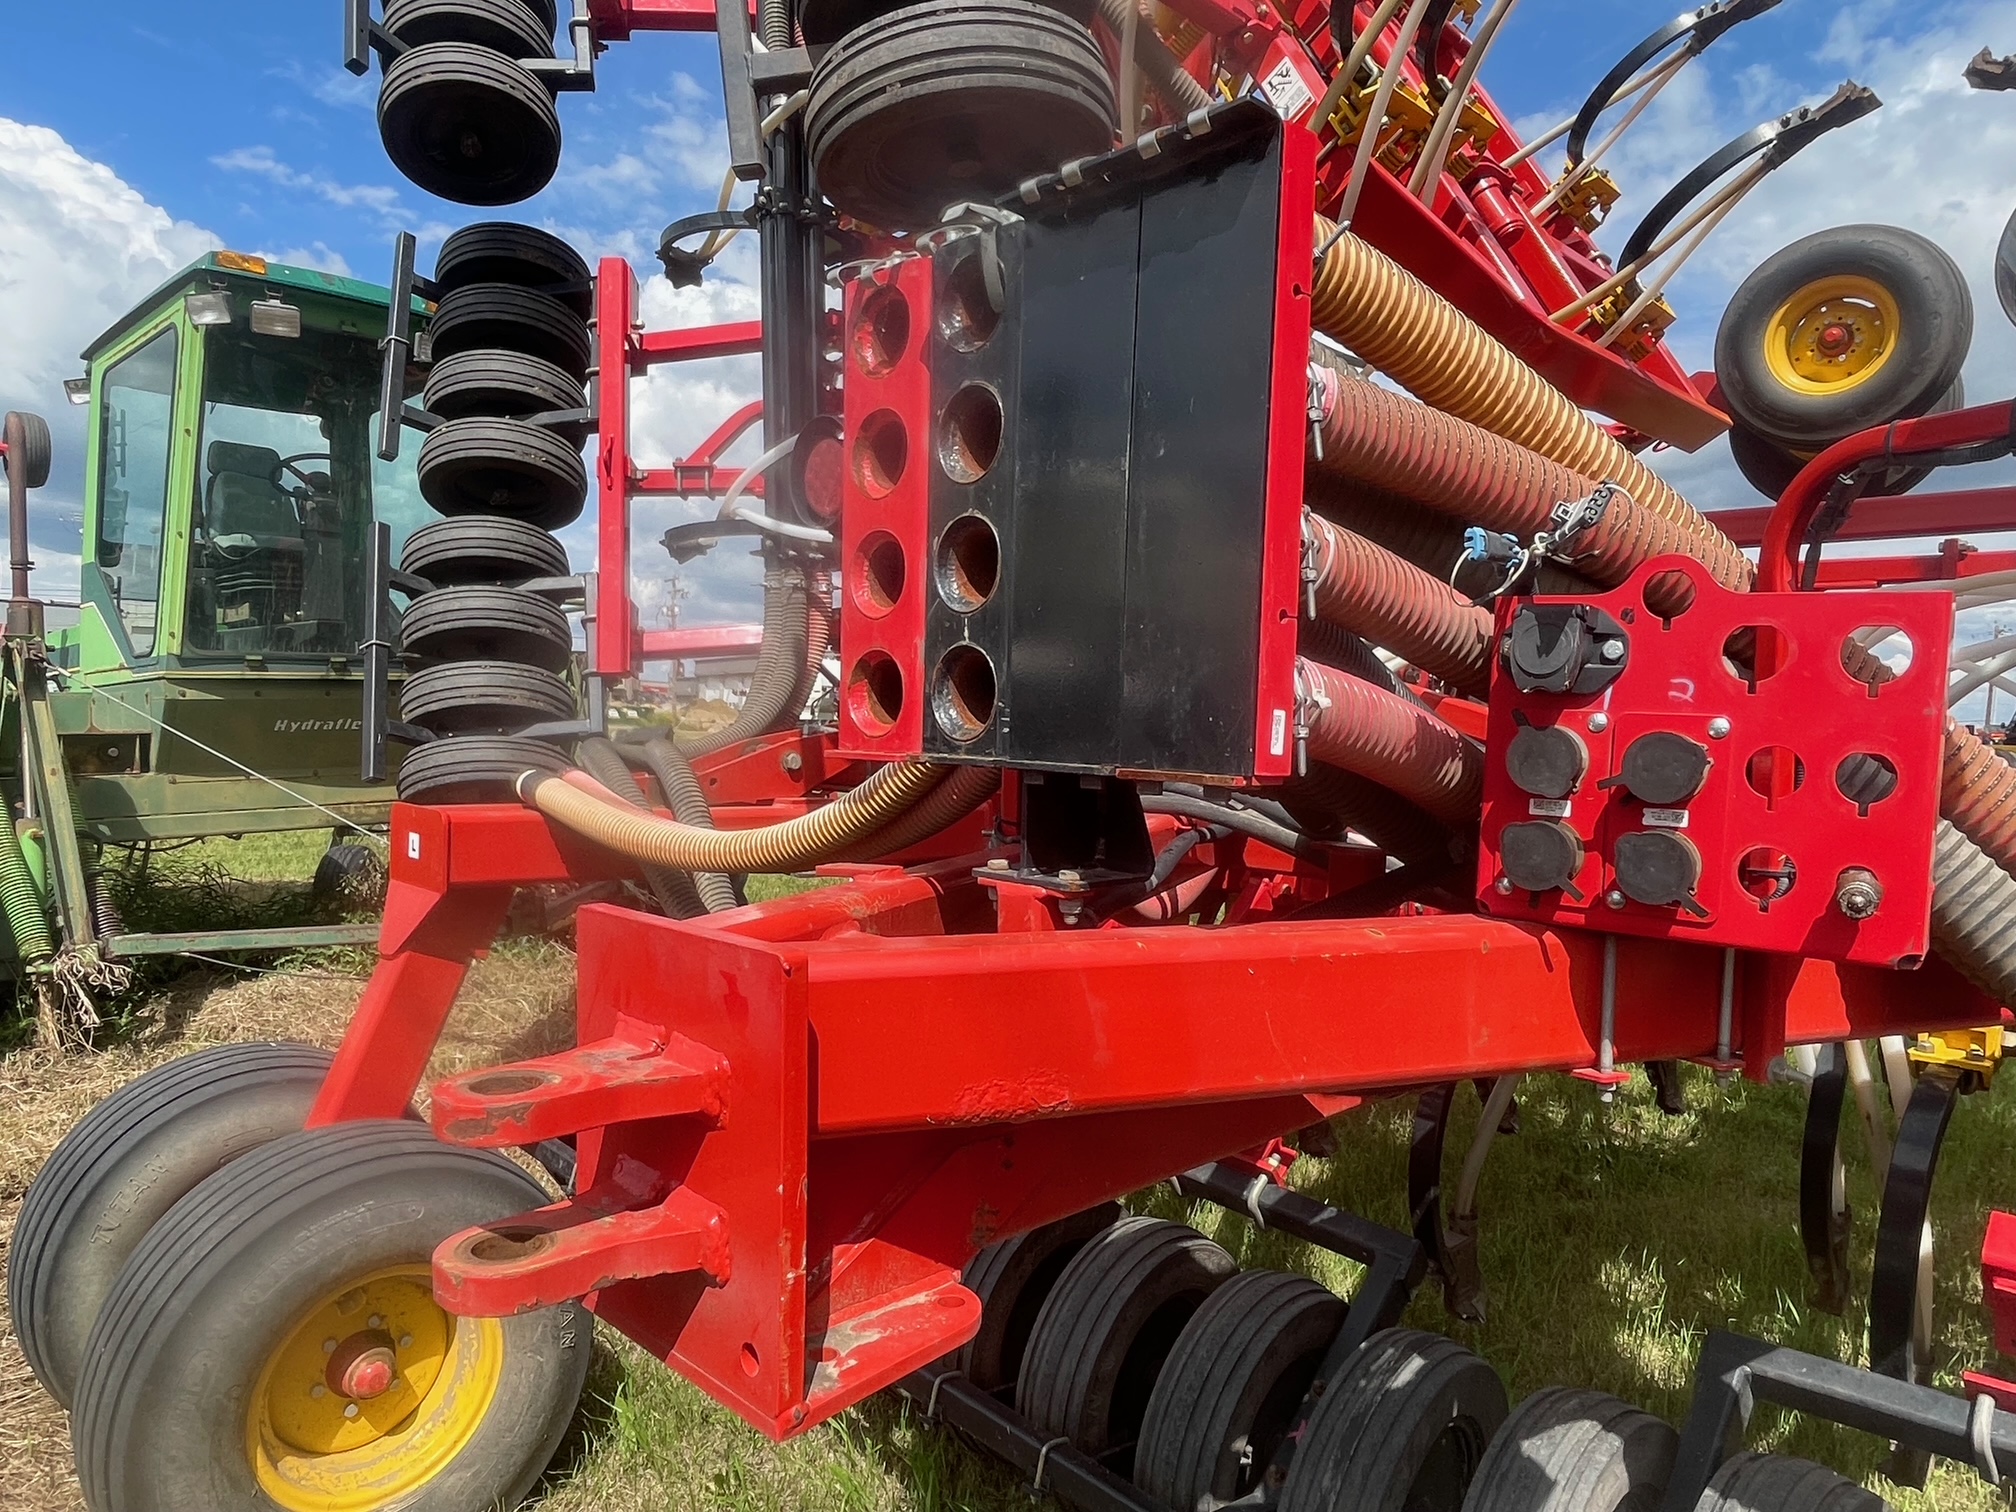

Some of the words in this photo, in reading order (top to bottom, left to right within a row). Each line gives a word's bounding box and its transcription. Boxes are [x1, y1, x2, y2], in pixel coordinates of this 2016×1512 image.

[1667, 677, 1696, 704] 2
[274, 718, 362, 733] Hydrafle
[89, 1153, 169, 1244] TITAN
[558, 1308, 576, 1349] AN
